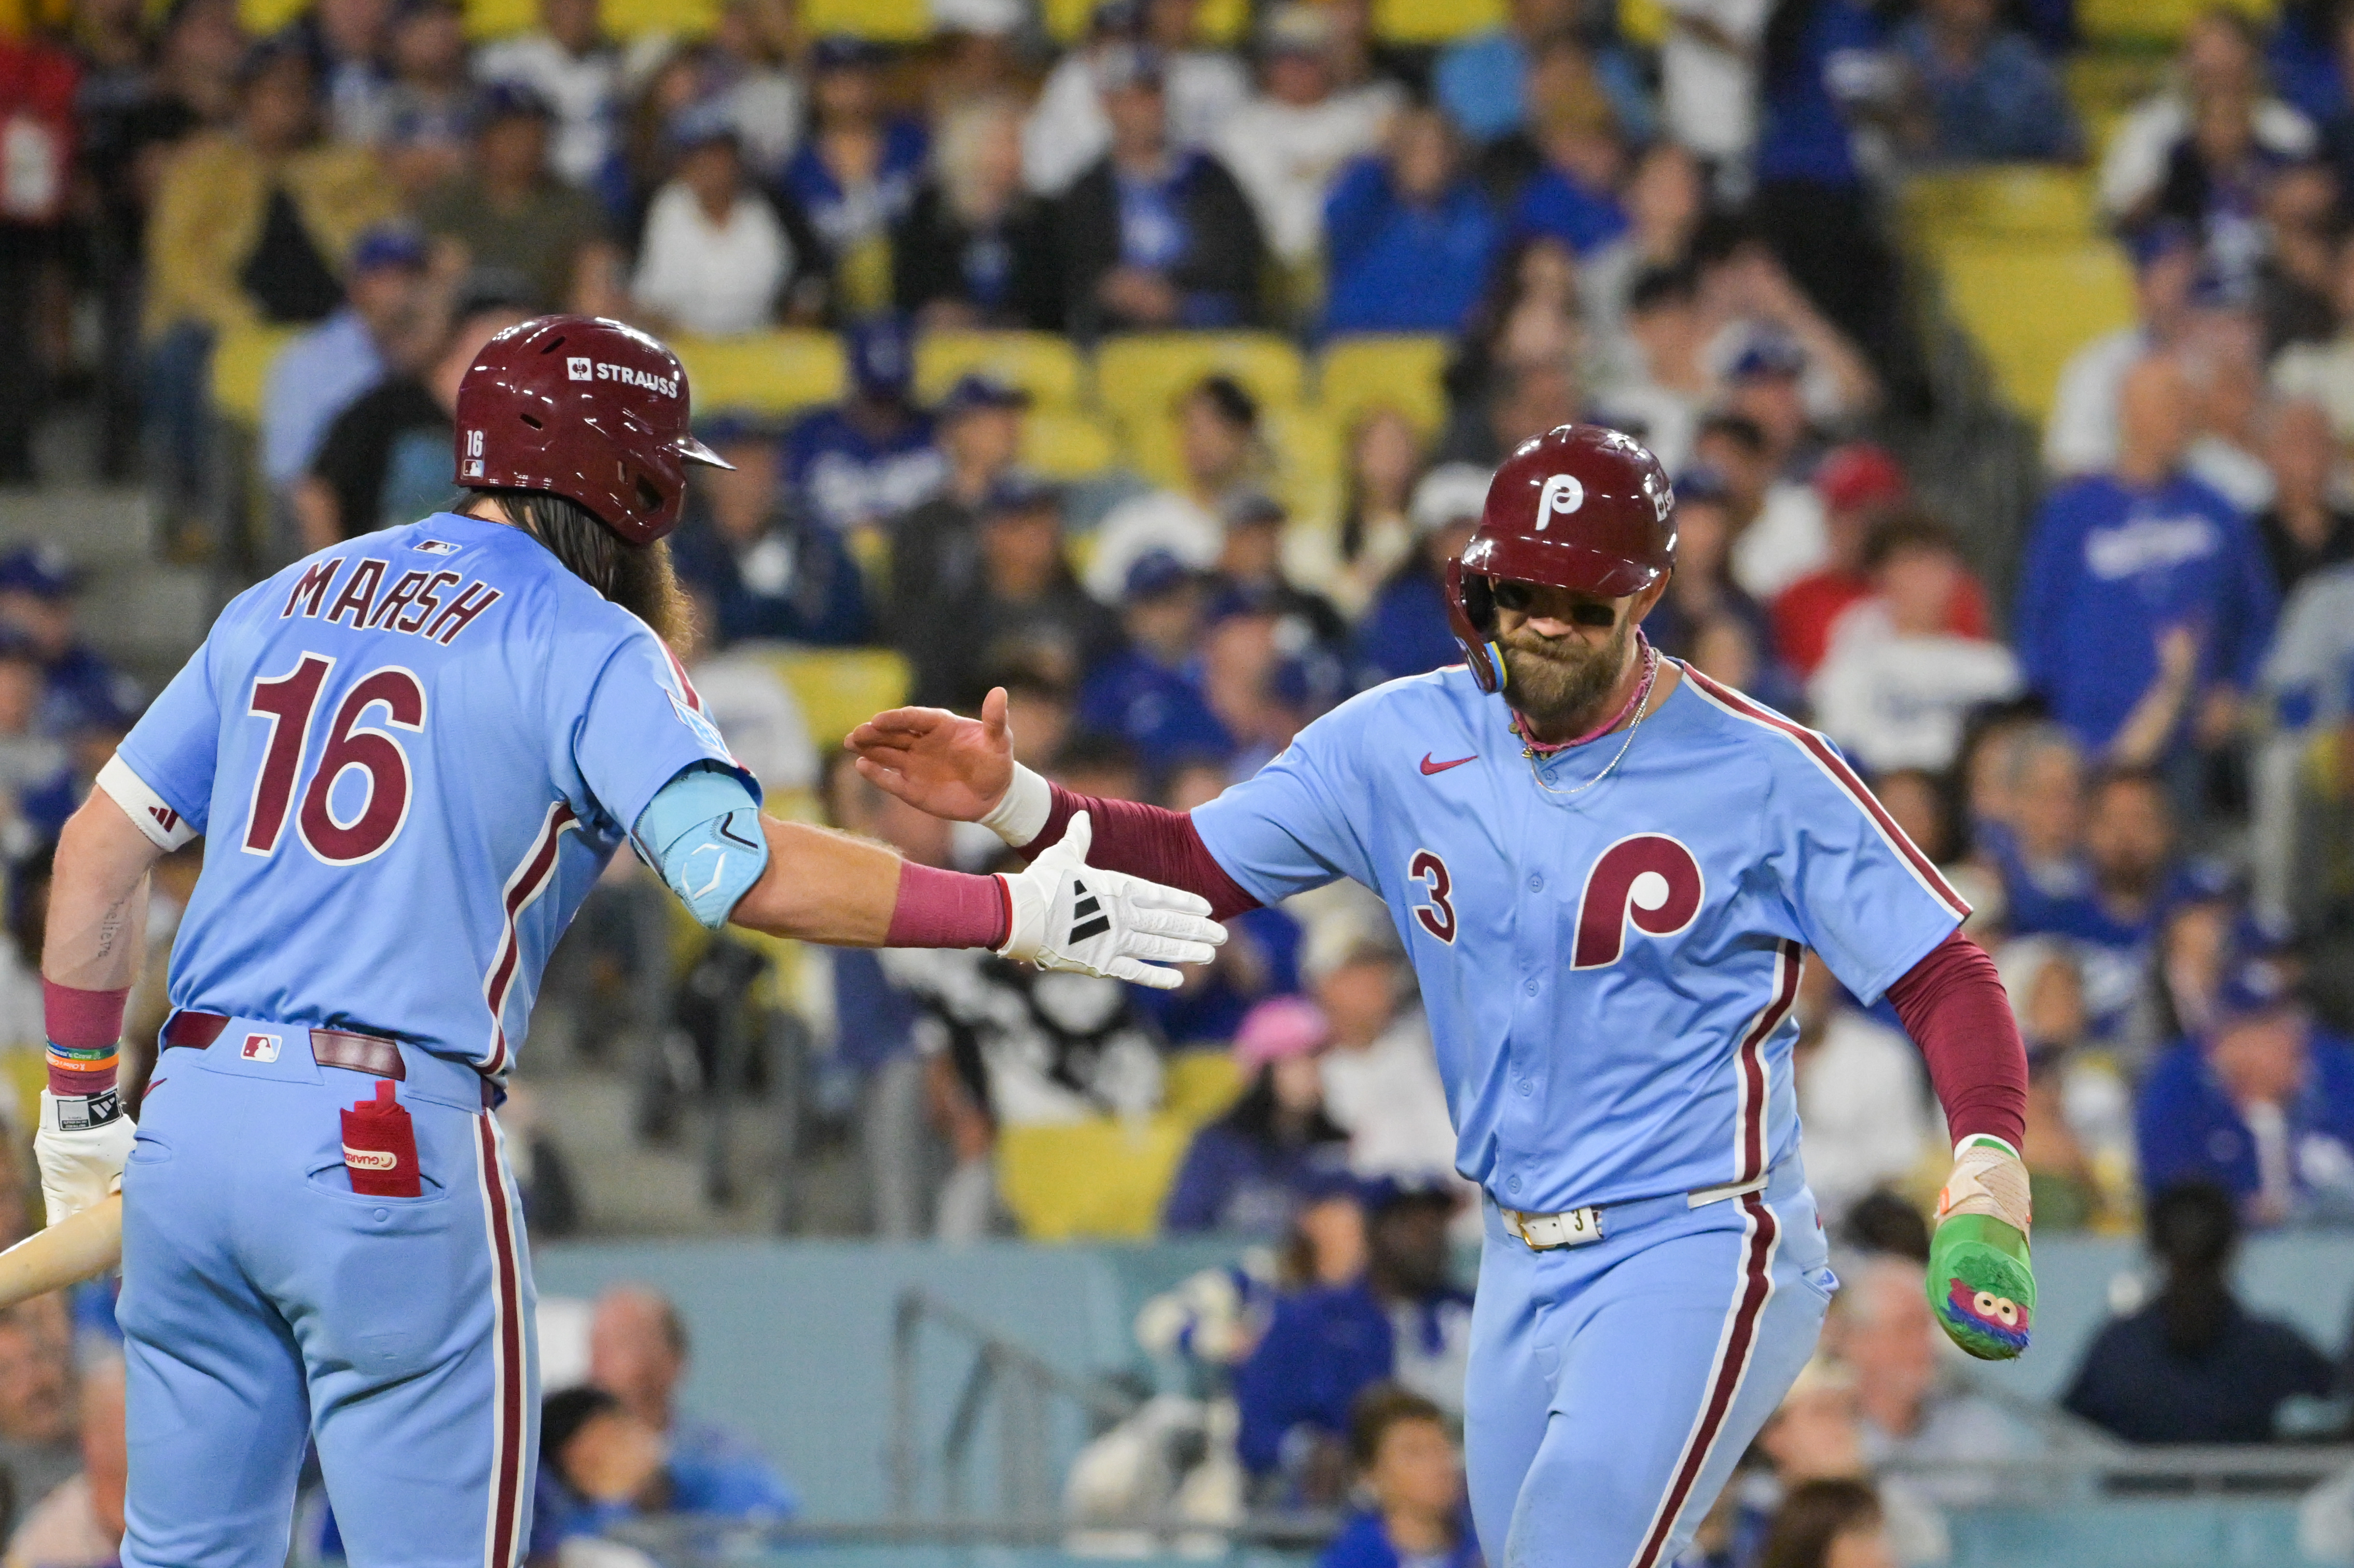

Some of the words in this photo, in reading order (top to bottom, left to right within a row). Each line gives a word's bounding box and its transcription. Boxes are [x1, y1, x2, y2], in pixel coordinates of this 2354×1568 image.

[597, 363, 677, 398] STRAUSS
[467, 430, 483, 457] 16
[1535, 474, 1584, 531] P
[279, 557, 504, 646] MARSH
[240, 650, 427, 866] 16
[1407, 848, 1457, 947] 3
[1570, 832, 1705, 970] P
